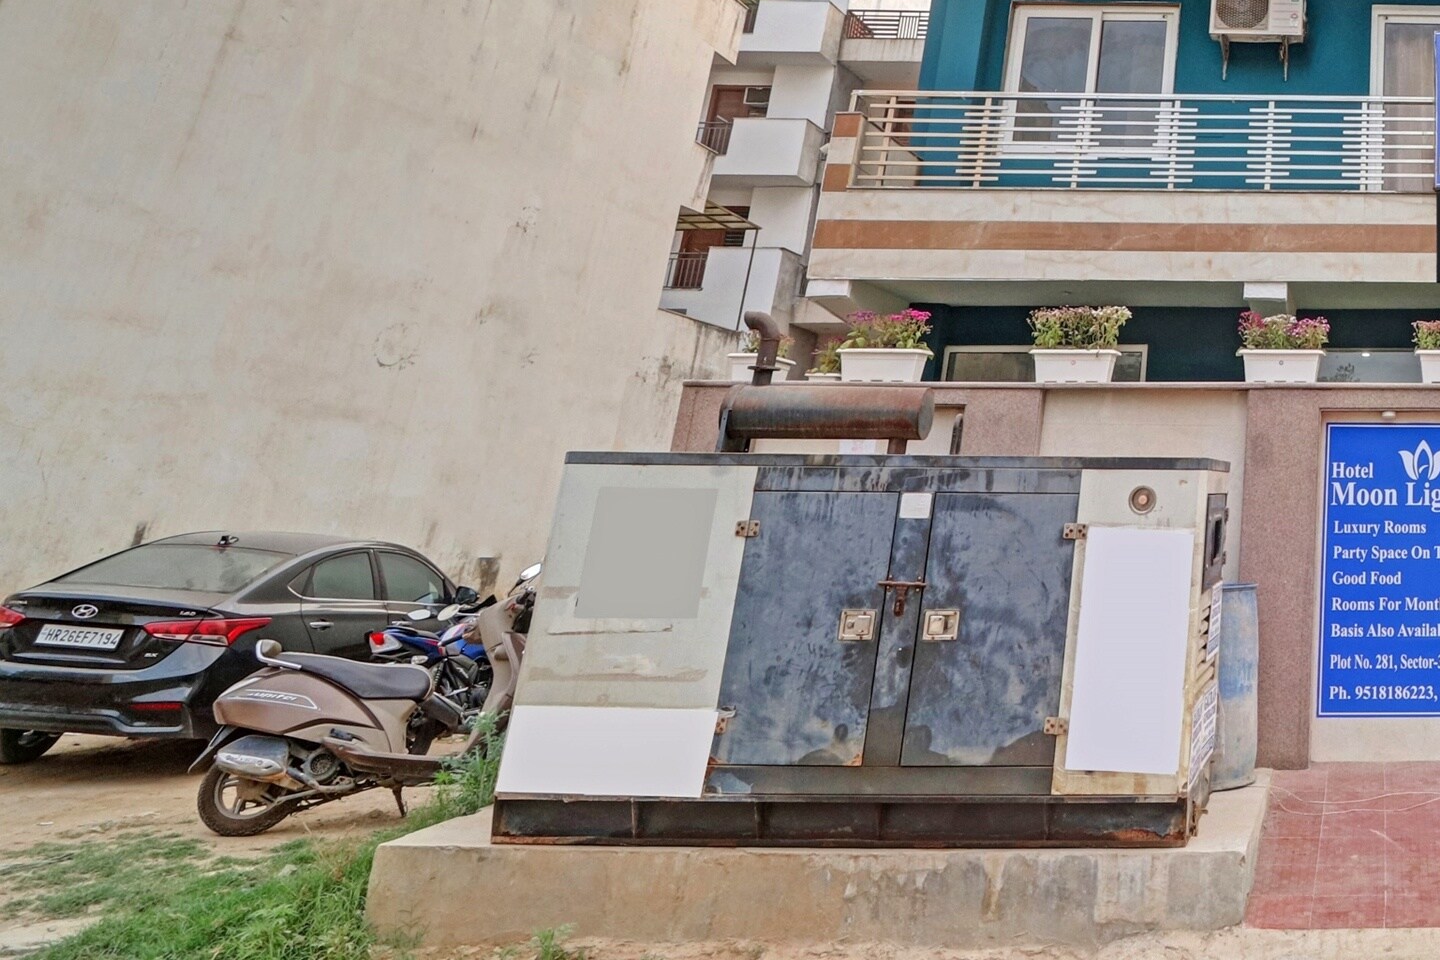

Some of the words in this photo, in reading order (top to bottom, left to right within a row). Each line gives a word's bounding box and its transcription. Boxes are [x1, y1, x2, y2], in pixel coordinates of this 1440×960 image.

[1332, 462, 1373, 478] Hotel
[1331, 482, 1398, 506] Moon
[1334, 521, 1380, 537] Luxury
[1384, 521, 1426, 534] Rooms
[1333, 546, 1368, 562] Party
[1371, 546, 1408, 562] Space
[1411, 546, 1430, 559] On
[1332, 571, 1366, 585] Good
[1370, 571, 1402, 585] Food
[1332, 597, 1375, 611] Rooms
[1379, 597, 1401, 611] For
[45, 628, 120, 645] HR26EF7194
[1331, 624, 1364, 637] Basis
[1367, 624, 1394, 637] Also
[1330, 655, 1351, 669] Plot
[1354, 655, 1372, 669] No.
[1376, 655, 1398, 672] 281,
[1329, 686, 1351, 700] Ph.
[1355, 686, 1438, 702] 9518186223,
